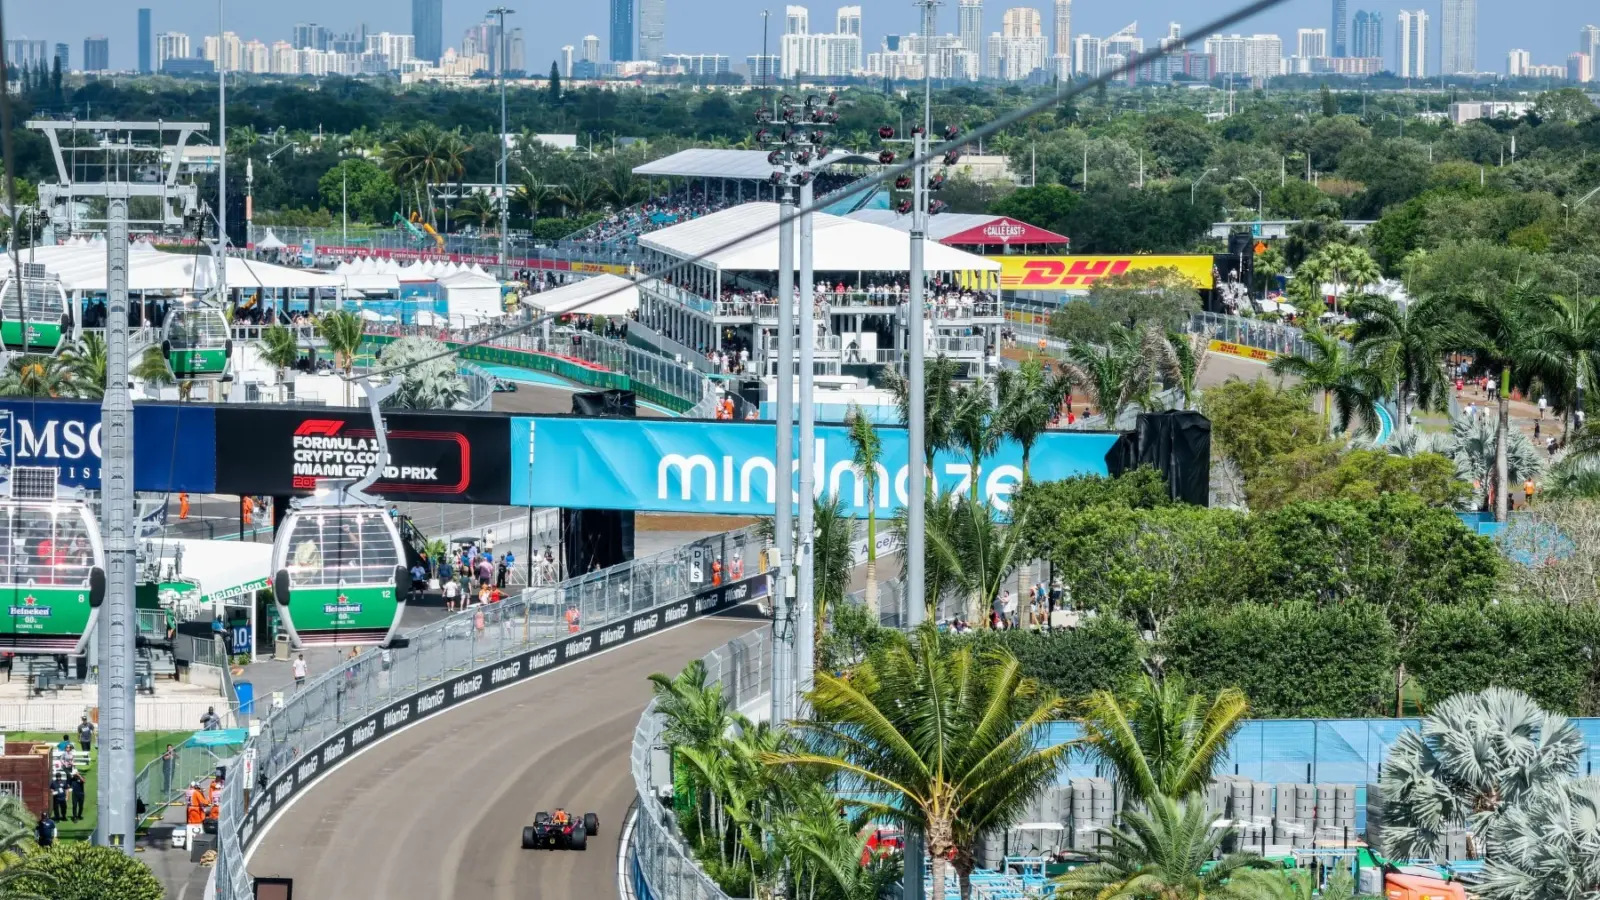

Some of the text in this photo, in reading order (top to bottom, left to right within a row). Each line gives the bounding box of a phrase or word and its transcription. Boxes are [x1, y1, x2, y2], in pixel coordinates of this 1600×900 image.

[988, 226, 1020, 235] CALLE EAST
[1021, 260, 1132, 285] DHL
[1220, 343, 1238, 354] DHL
[293, 436, 380, 451] FORMULA 1
[293, 463, 343, 476] MIAMI
[401, 467, 438, 480] PRIX
[78, 594, 85, 603] 8
[208, 583, 261, 603] Heineken
[381, 590, 391, 599] 12
[10, 607, 49, 615] Heineken
[633, 613, 658, 634] #MiamiGP
[599, 625, 626, 646] #MiamiGP
[565, 636, 591, 658] #MiamiGP
[529, 648, 557, 671] #MiamiGP
[491, 661, 520, 684] #MiamiGP
[453, 674, 482, 699] #MiamiGP
[417, 688, 445, 714] #MiamiGP
[384, 703, 410, 729] #MiamiGP
